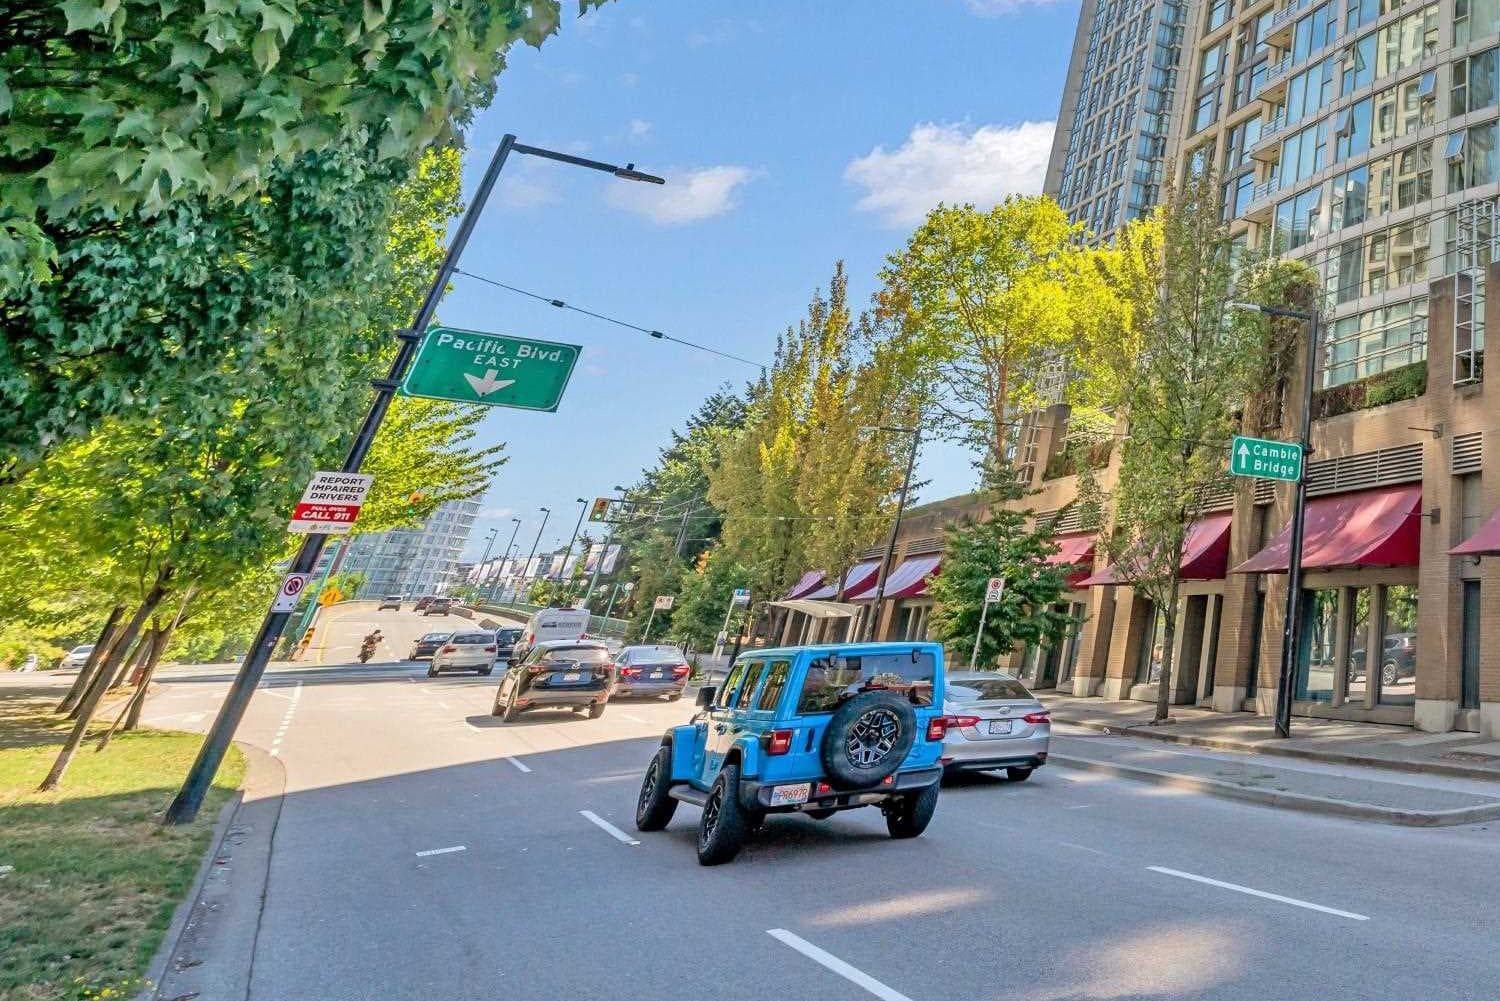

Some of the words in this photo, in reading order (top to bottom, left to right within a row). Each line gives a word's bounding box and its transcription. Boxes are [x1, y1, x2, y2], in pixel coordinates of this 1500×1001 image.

[437, 333, 506, 356] Pacific
[516, 344, 564, 363] Blvd.
[473, 354, 522, 369] EAST
[1253, 459, 1294, 478] Bridge
[319, 476, 366, 486] REPORT
[311, 484, 365, 493] IMPAIRED
[309, 492, 359, 501] DRIVERS
[301, 511, 331, 520] CALL
[333, 512, 352, 521] 911
